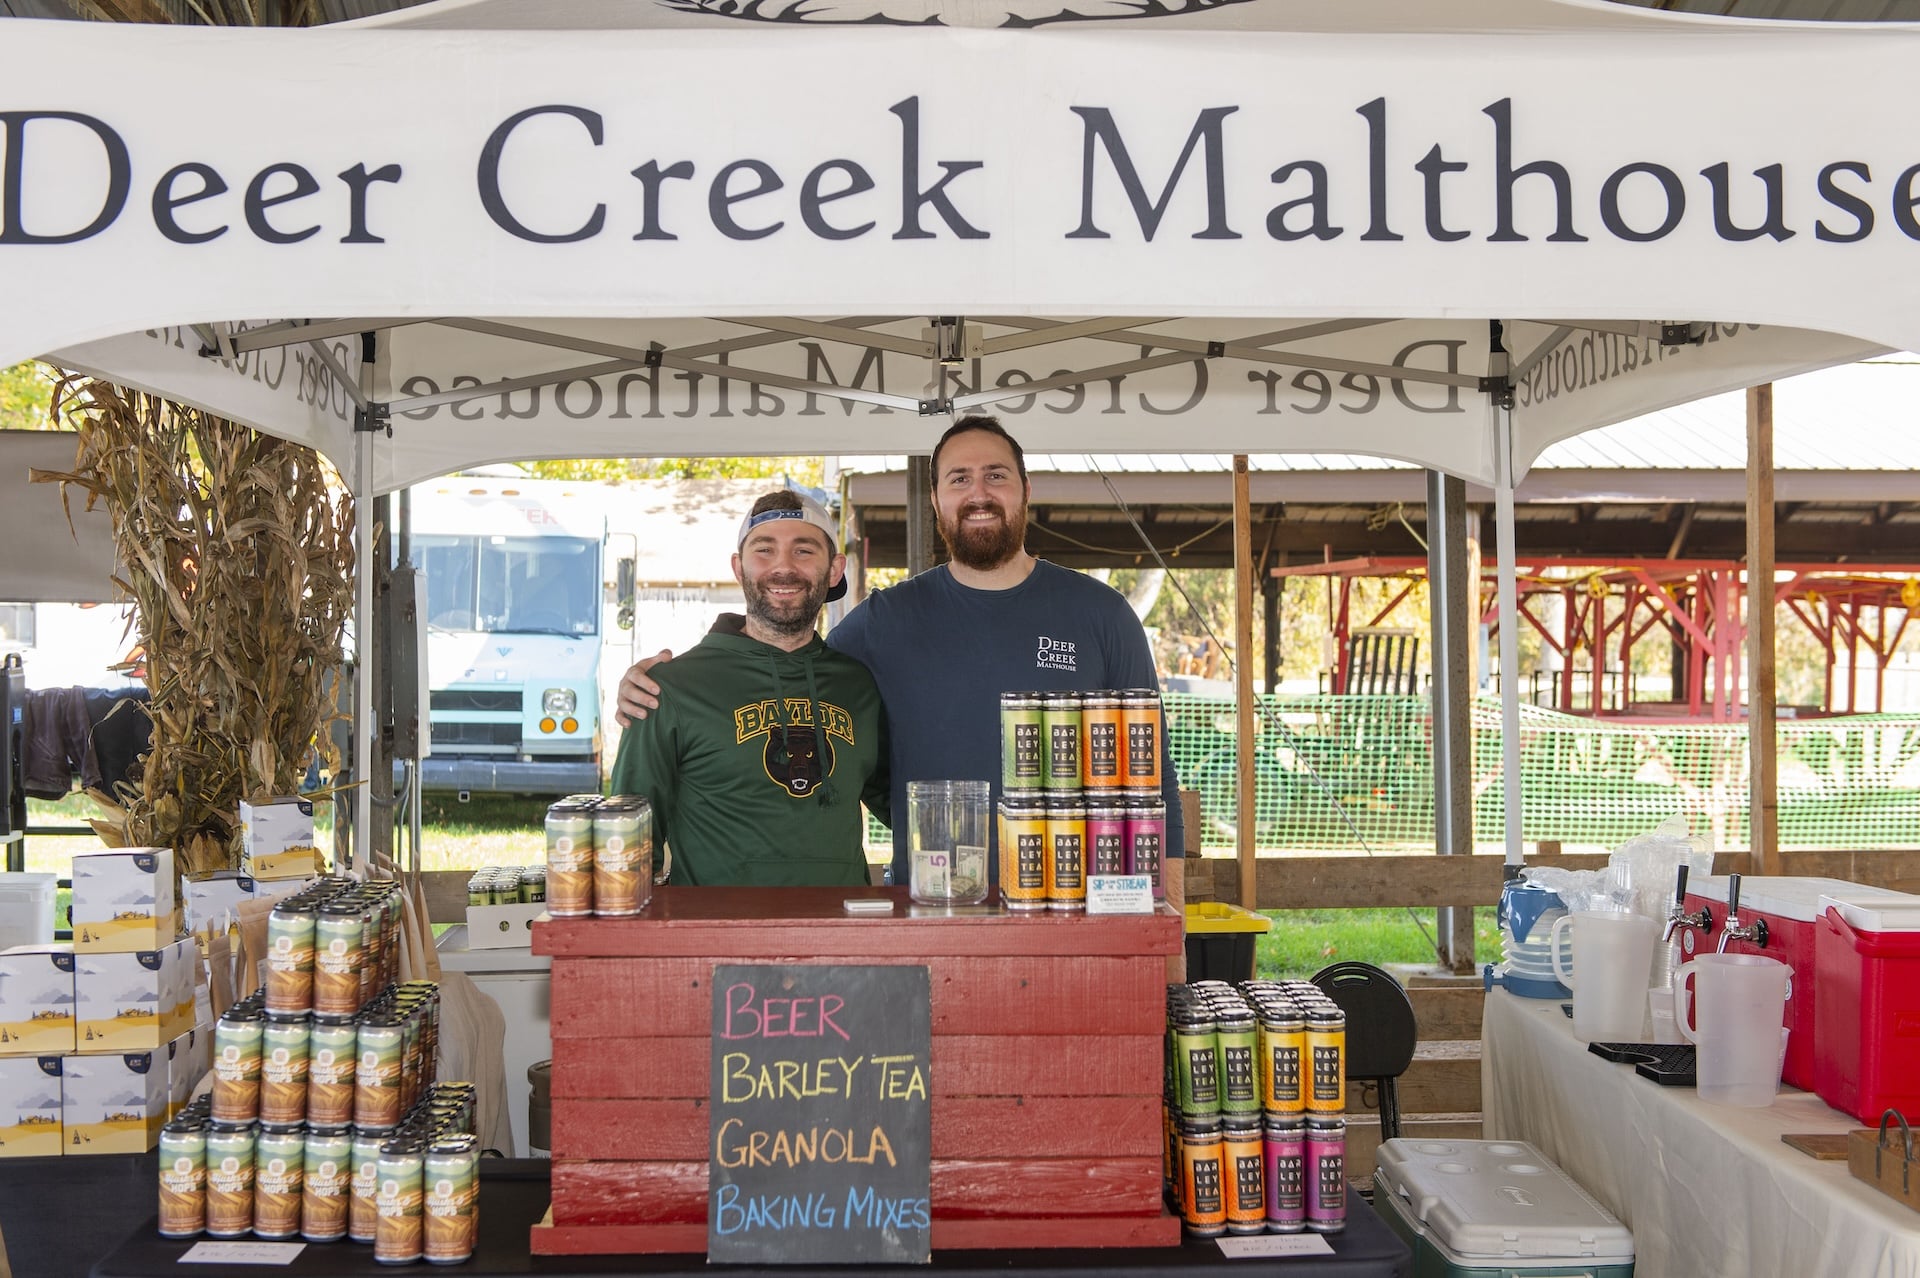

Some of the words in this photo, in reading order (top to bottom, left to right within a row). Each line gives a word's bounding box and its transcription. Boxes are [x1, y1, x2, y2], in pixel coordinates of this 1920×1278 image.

[0, 110, 402, 244] Deer
[477, 95, 991, 243] Creek
[1017, 728, 1039, 737] BAR
[1053, 729, 1076, 737] BAR
[1092, 726, 1114, 735] BAR
[1130, 726, 1152, 735] BAR
[1017, 740, 1039, 749] LEY
[1053, 741, 1076, 749] LEY
[1093, 739, 1115, 747] LEY
[1130, 739, 1152, 747] LEY
[1018, 752, 1039, 761] TEA
[1054, 753, 1076, 761] TEA
[1093, 751, 1115, 760] TEA
[1131, 751, 1153, 760] TEA
[1020, 838, 1042, 847] BAR
[1057, 838, 1079, 847] BAR
[1098, 838, 1120, 847] BAR
[1136, 837, 1158, 846] BAR
[1020, 850, 1042, 859] LEY
[1057, 851, 1080, 859] LEY
[1098, 851, 1120, 859] LEY
[1136, 850, 1158, 858] LEY
[1021, 863, 1042, 872] TEA
[1058, 863, 1080, 872] TEA
[1098, 863, 1120, 871] TEA
[1136, 862, 1158, 870] TEA
[1192, 1052, 1214, 1061] BAR
[1227, 1051, 1250, 1060] BAR
[1275, 1050, 1298, 1060] BAR
[1315, 1050, 1338, 1060] BAR
[1193, 1064, 1215, 1074] LEY
[1228, 1063, 1250, 1072] LEY
[1276, 1062, 1298, 1072] LEY
[1316, 1062, 1338, 1071] LEY
[722, 1052, 863, 1103] BARLEY
[870, 1054, 926, 1101] TEA
[1194, 1077, 1216, 1086] TEA
[1229, 1075, 1251, 1084] TEA
[1276, 1075, 1298, 1084] TEA
[1316, 1074, 1338, 1084] TEA
[716, 1118, 897, 1168] GRANOLA
[1196, 1162, 1218, 1172] BAR
[1238, 1159, 1260, 1169] BAR
[1279, 1159, 1301, 1168] BAR
[1320, 1158, 1342, 1168] BAR
[1239, 1171, 1260, 1181] LEY
[1280, 1171, 1301, 1180] LEY
[1321, 1170, 1342, 1180] LEY
[1196, 1175, 1218, 1185] LEY
[1197, 1187, 1219, 1197] TEA
[1240, 1184, 1261, 1193] TEA
[1280, 1184, 1301, 1193] TEA
[1321, 1184, 1343, 1193] TEA
[715, 1183, 836, 1236] BAKING
[843, 1184, 930, 1231] MIXES
